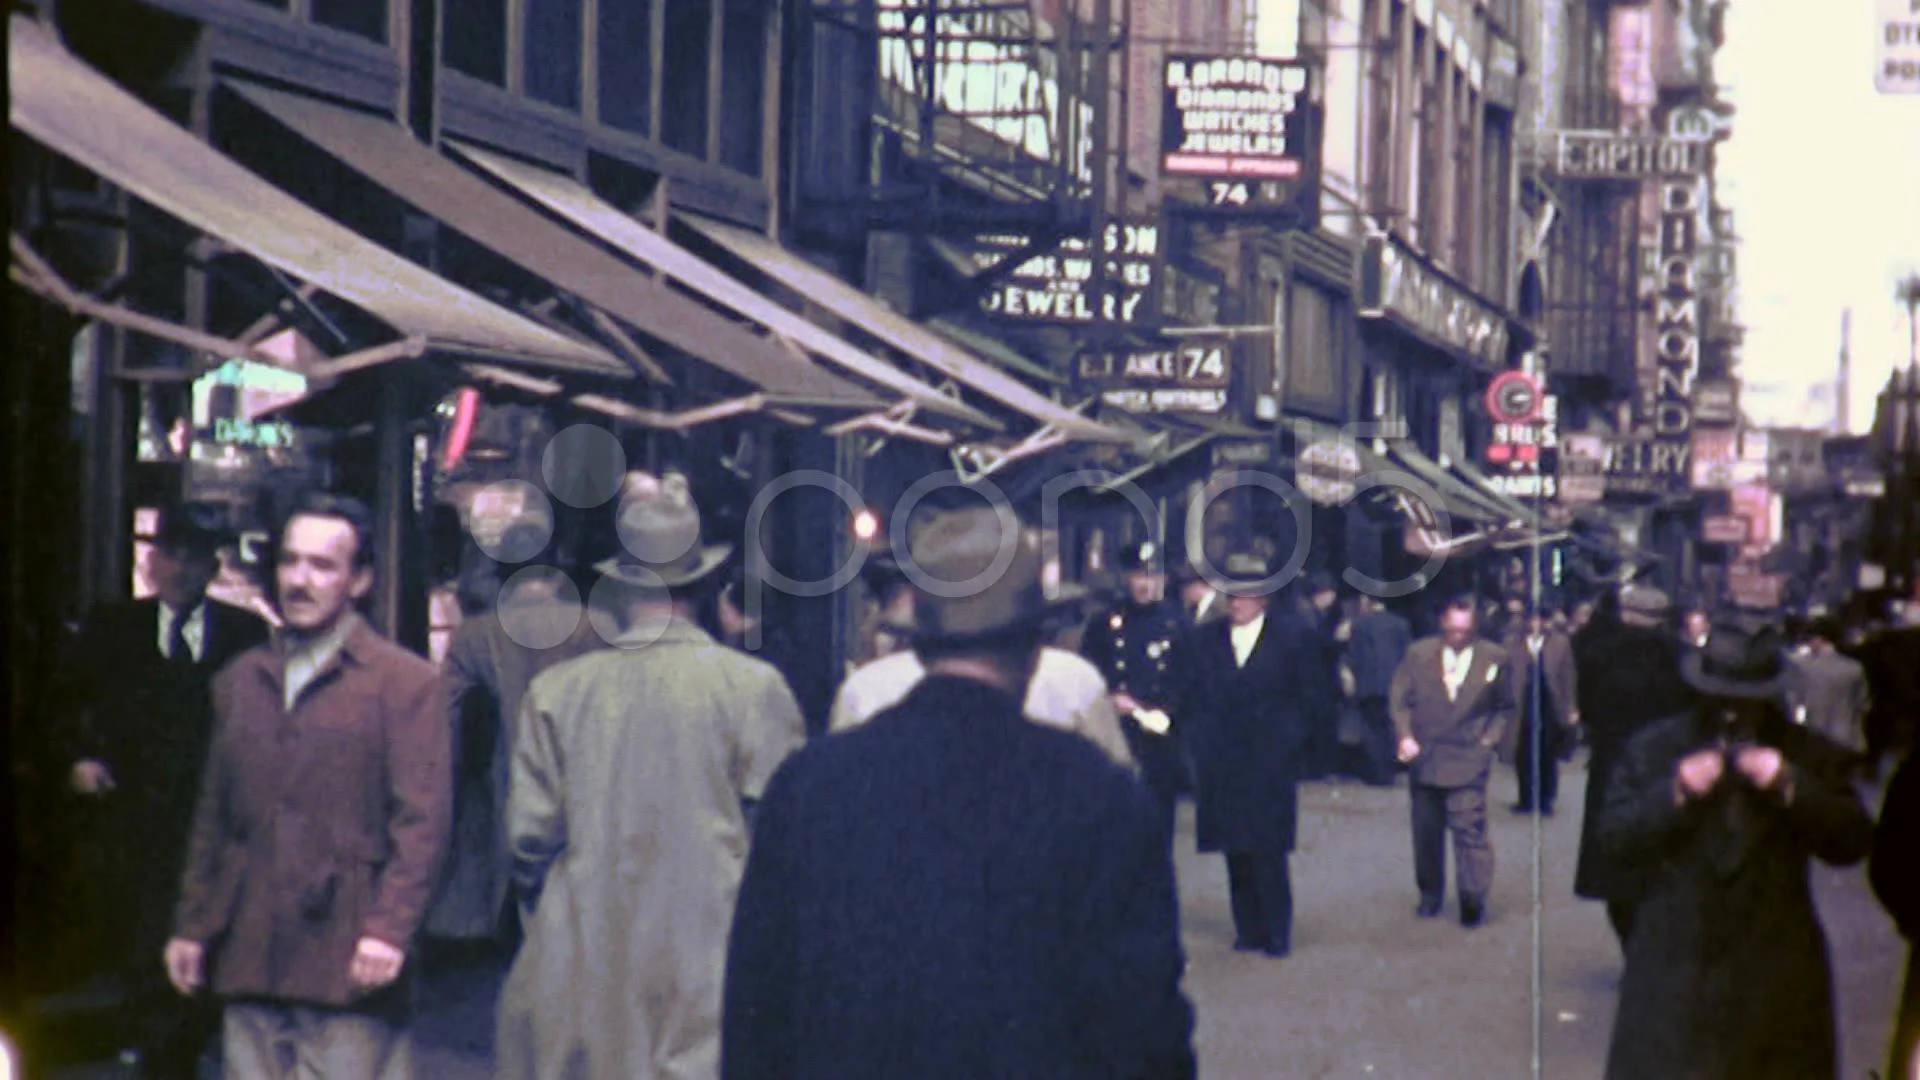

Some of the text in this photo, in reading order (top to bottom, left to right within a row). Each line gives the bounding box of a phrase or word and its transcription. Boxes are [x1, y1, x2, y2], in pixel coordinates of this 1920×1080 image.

[1177, 88, 1295, 112] DIAMONDS
[1183, 111, 1285, 133] WATCHES
[1181, 133, 1286, 155] JEWELRY
[1211, 182, 1249, 205] 74
[1657, 183, 1697, 434] DIAMOND
[1184, 348, 1225, 379] 74
